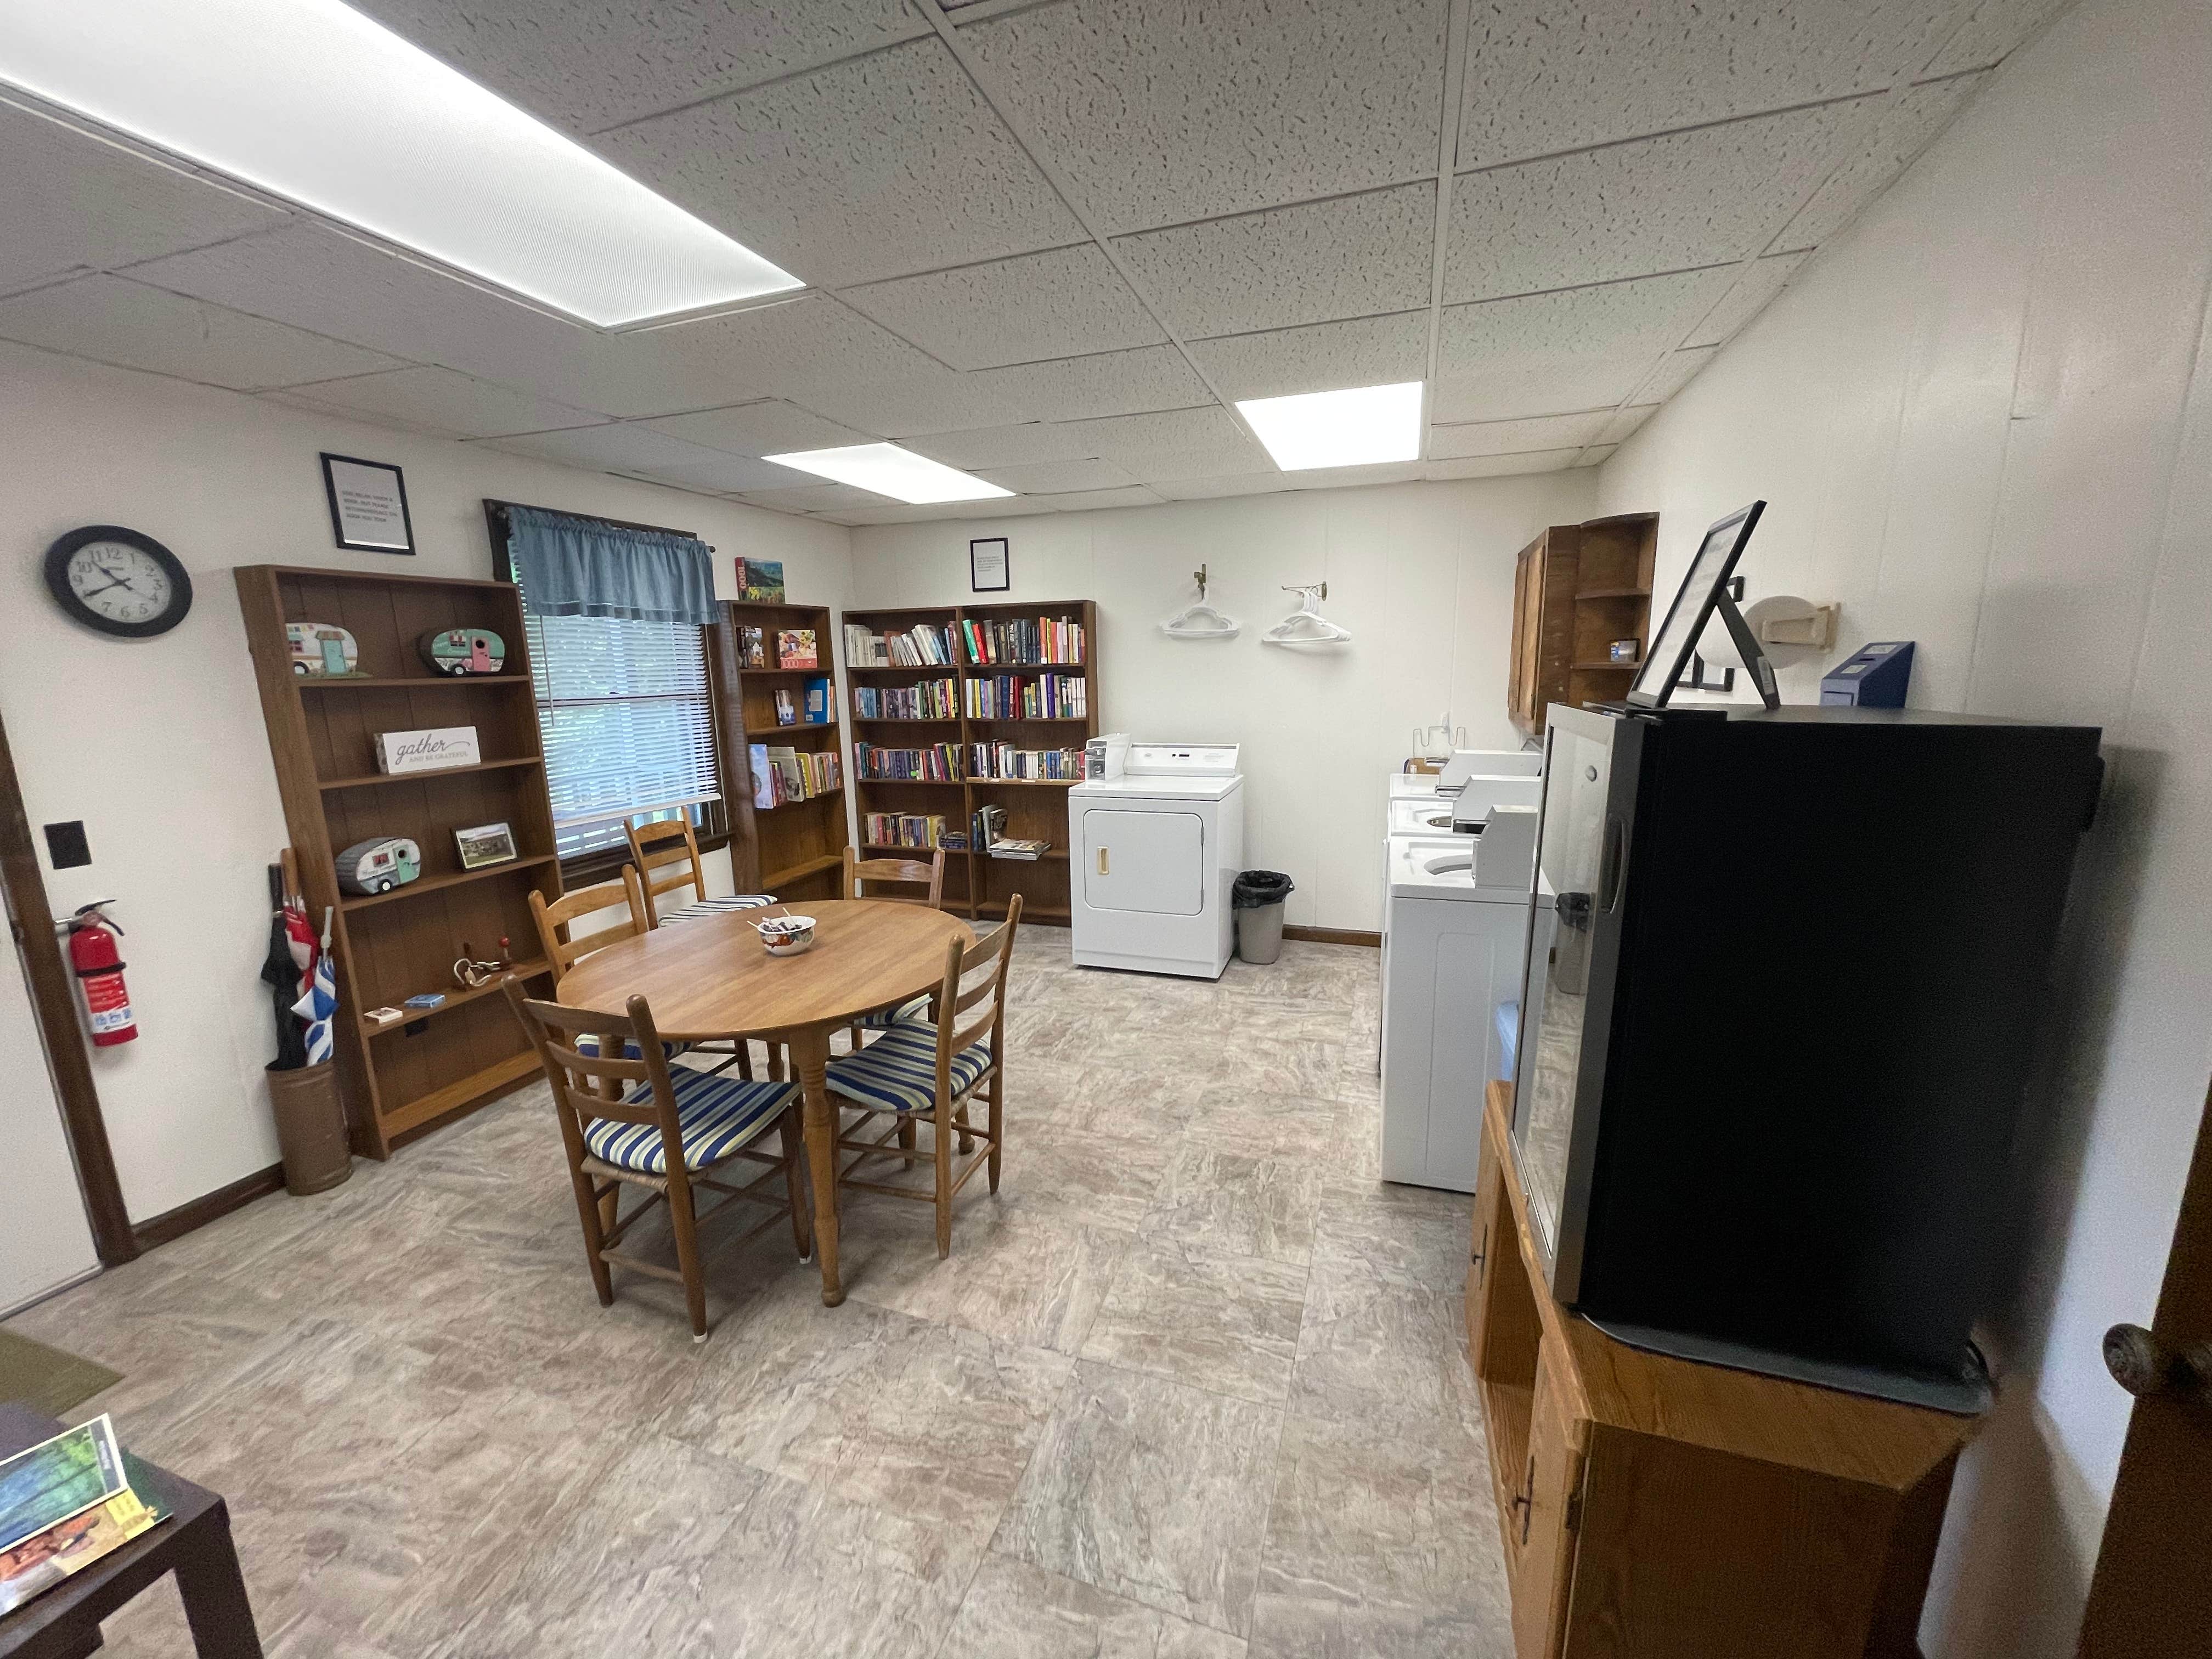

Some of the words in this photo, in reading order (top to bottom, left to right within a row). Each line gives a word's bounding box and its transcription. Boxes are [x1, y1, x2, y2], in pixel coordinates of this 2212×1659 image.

[90, 550, 102, 562] 11
[106, 547, 123, 560] 12
[130, 552, 136, 564] 1
[76, 561, 93, 573] 10
[145, 565, 155, 576] 2
[72, 574, 83, 585] 9
[153, 578, 163, 591] 3
[149, 592, 159, 602] 4
[101, 601, 112, 612] 7
[121, 606, 131, 618] 6
[139, 603, 148, 614] 5
[395, 733, 471, 765] gather
